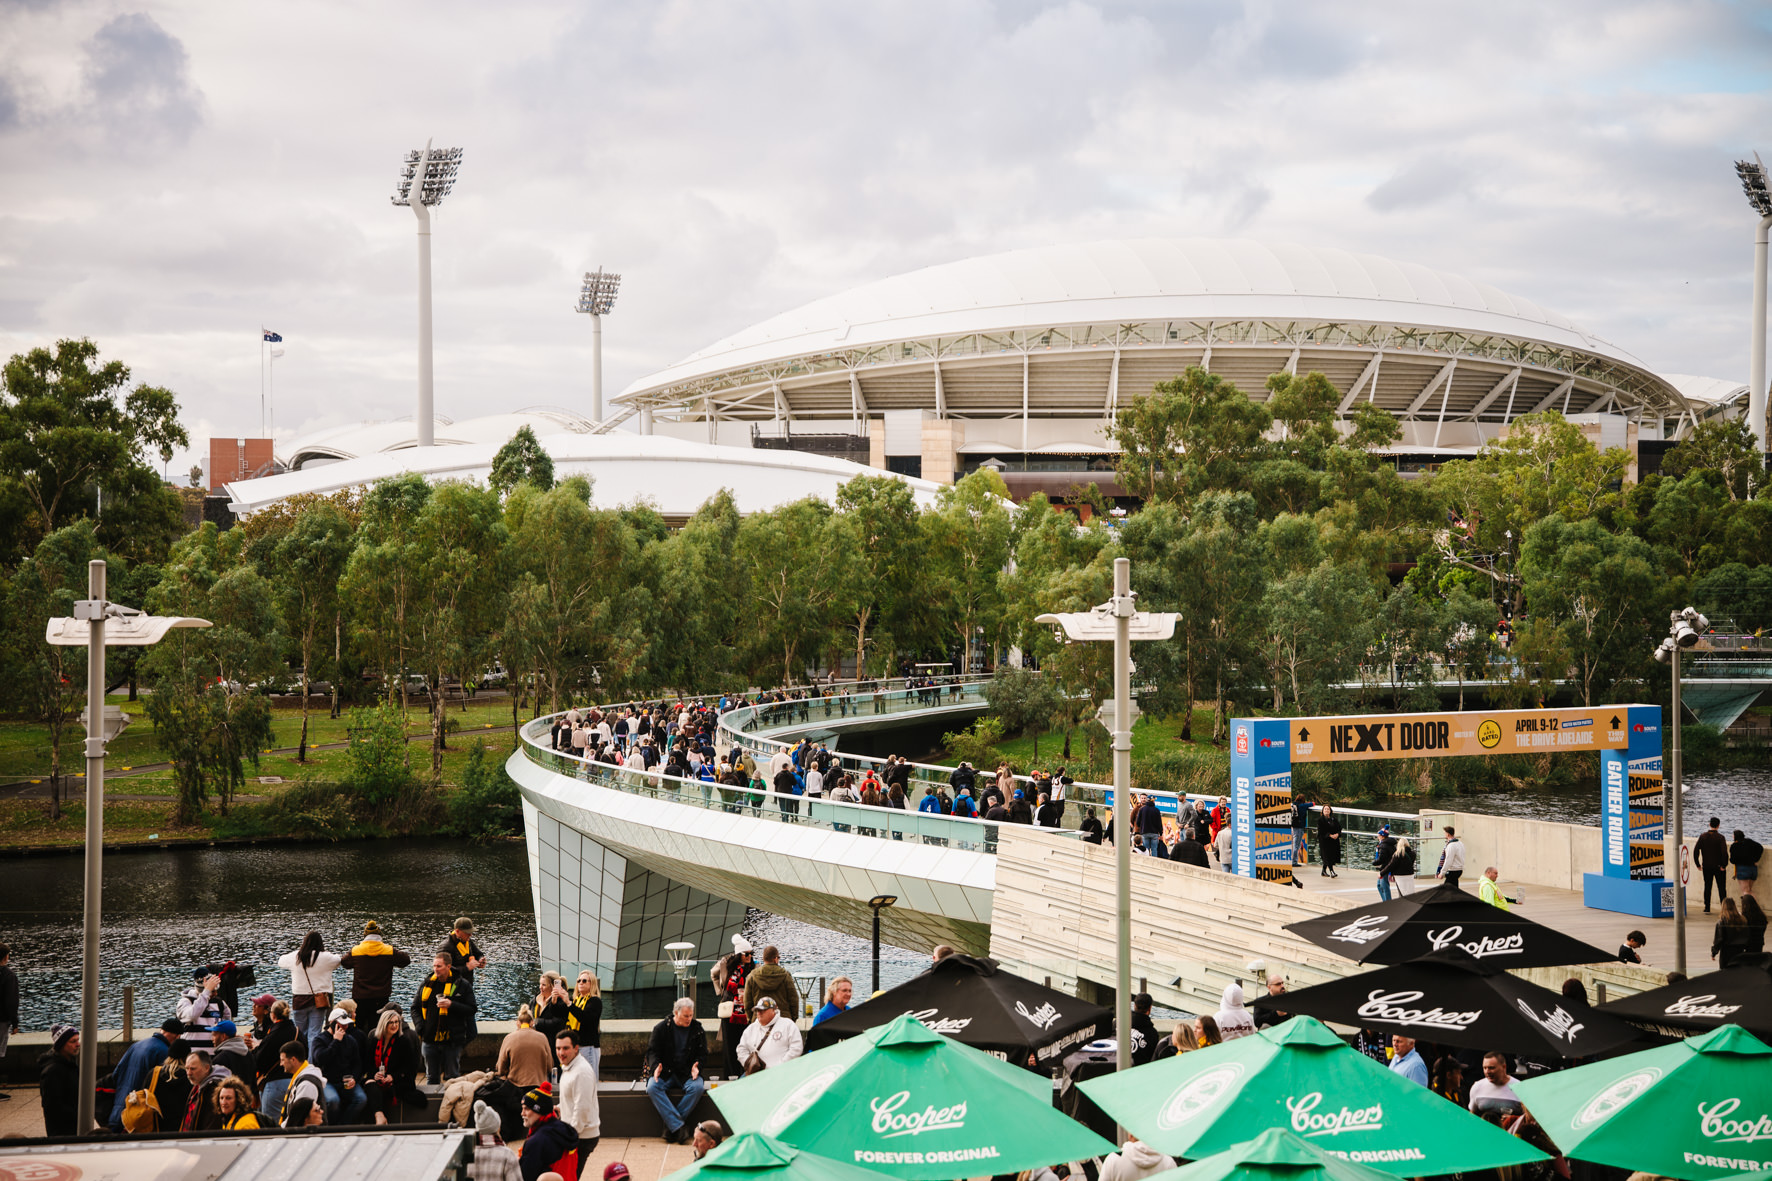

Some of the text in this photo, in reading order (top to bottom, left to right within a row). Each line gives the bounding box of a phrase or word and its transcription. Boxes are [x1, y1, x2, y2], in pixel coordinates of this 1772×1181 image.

[1515, 718, 1558, 732] APRIL 9-12
[1330, 721, 1449, 753] NEXT DOOR
[1481, 733, 1499, 742] RATED
[1515, 731, 1594, 747] THE DRIVE ADELAIDE
[1628, 759, 1662, 771] GATHER
[1255, 776, 1291, 788] GATHER
[1629, 776, 1662, 793] ROUND
[926, 804, 932, 813] 4
[1255, 793, 1291, 811] ROUND
[1629, 795, 1663, 807] GATHER
[1255, 812, 1292, 825] GATHER
[1607, 760, 1624, 866] GATHER ROUND
[1629, 811, 1663, 829] ROUND
[1236, 777, 1251, 877] GATHER ROUN
[1629, 829, 1663, 841] GATHER
[1255, 830, 1292, 849] ROUND
[1255, 849, 1292, 861] GATHER
[1630, 846, 1664, 863] ROUND
[1256, 866, 1292, 882] ROUND
[1630, 866, 1664, 877] GATHER
[1326, 915, 1389, 944] Coopers
[1427, 925, 1524, 959] Copers
[1358, 989, 1483, 1031] Coopers
[1664, 994, 1743, 1018] Coopers
[1014, 1000, 1062, 1031] Coopers
[983, 1049, 1008, 1062] NED
[870, 1090, 967, 1139] Coopers
[1286, 1092, 1383, 1137] Coopers
[1697, 1098, 1772, 1143] Coop
[854, 1146, 1000, 1164] FOREVER ORIGINAL
[1350, 1148, 1426, 1163] ORIGINAL
[1683, 1151, 1761, 1172] FOREVER
